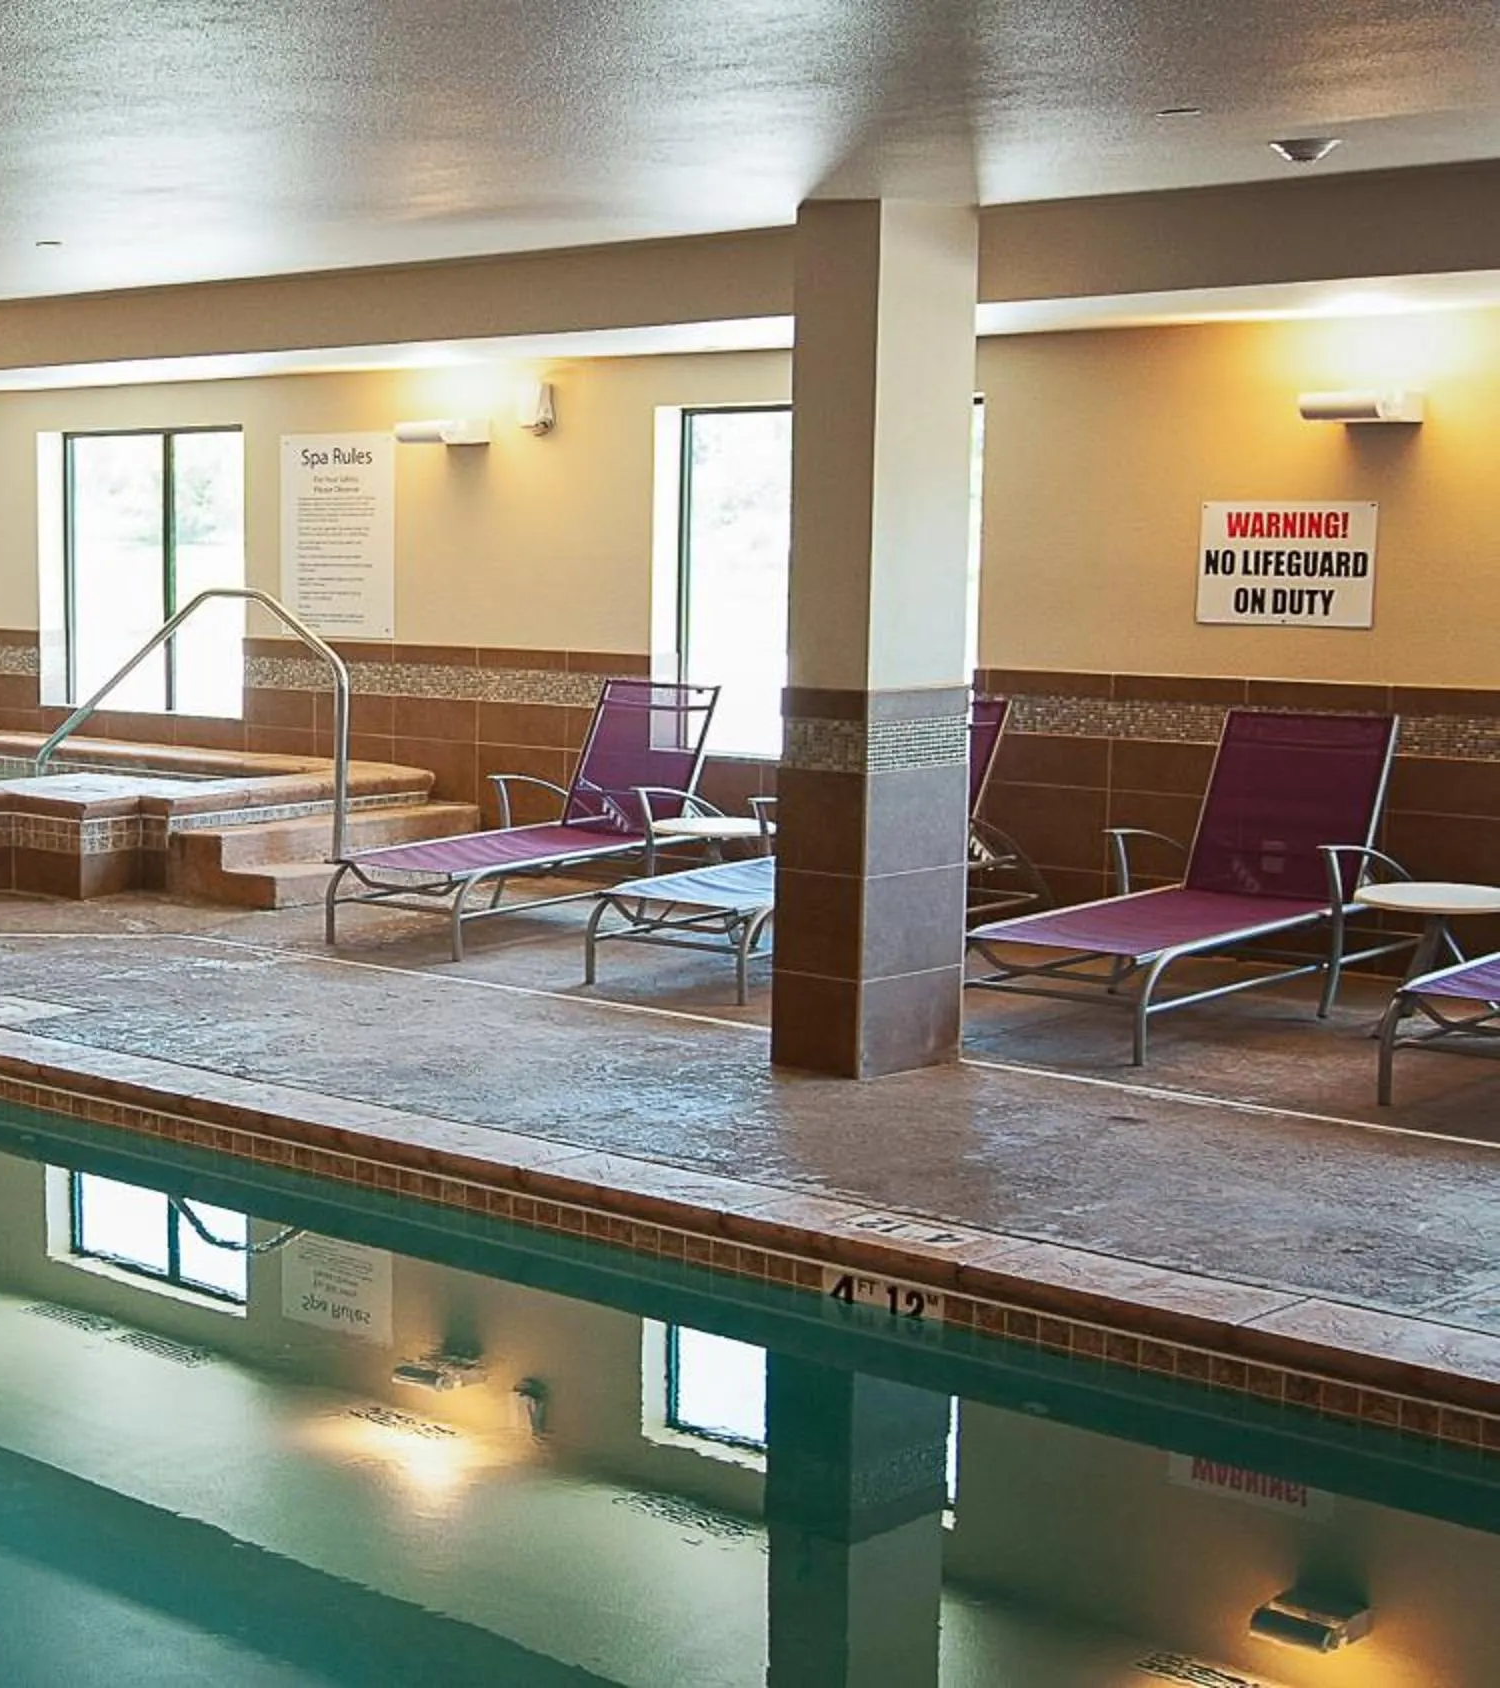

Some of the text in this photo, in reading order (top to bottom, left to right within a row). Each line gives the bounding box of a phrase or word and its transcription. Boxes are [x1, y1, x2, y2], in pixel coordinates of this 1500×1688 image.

[301, 447, 373, 470] Spa Rules
[1226, 511, 1349, 539] WARNING!
[1204, 549, 1369, 578] NO LIFEGUARD
[1234, 587, 1335, 616] ON DUTY
